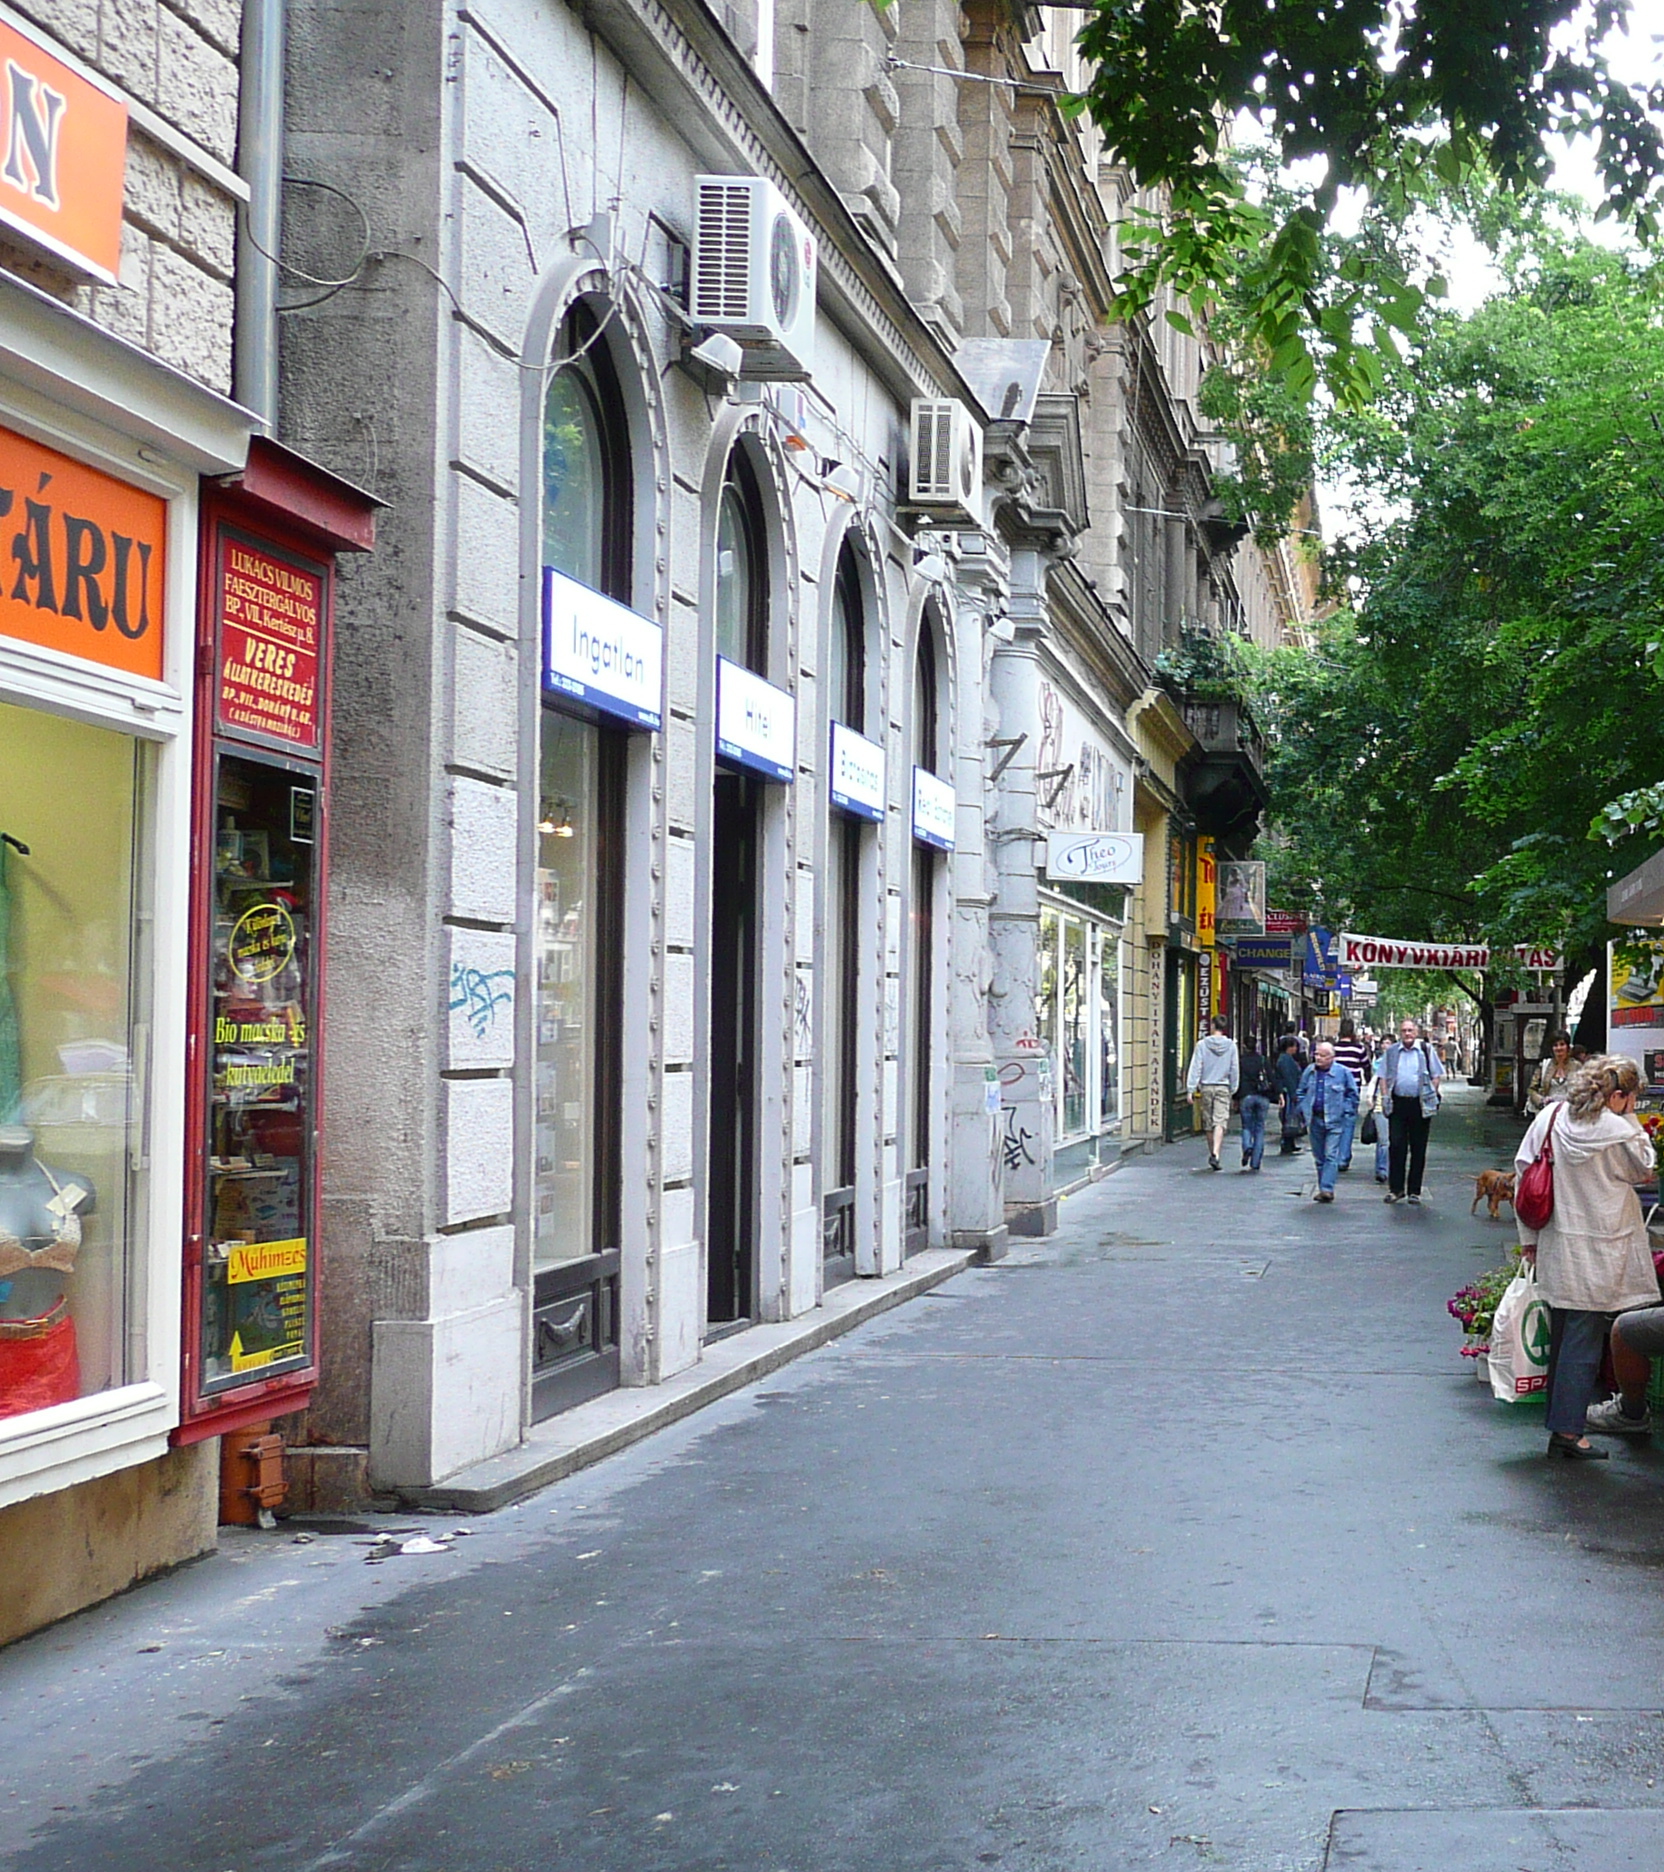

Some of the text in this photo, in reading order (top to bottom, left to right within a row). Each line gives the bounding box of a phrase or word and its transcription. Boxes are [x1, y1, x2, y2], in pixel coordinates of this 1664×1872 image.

[231, 549, 313, 601] LUKÁCS VILMOS
[225, 573, 316, 626] FAESZTERGÁLYOS
[263, 610, 296, 638] Kertész
[245, 637, 296, 678] VERES
[573, 613, 644, 684] Ingatlan
[223, 656, 314, 706] ÁLLATKERESKEDÉS
[1067, 838, 1116, 874] Theo
[1239, 947, 1290, 959] CHANGE
[215, 1016, 237, 1043] Bio
[240, 1016, 285, 1042] macska
[226, 1057, 295, 1087] kutyaeledel
